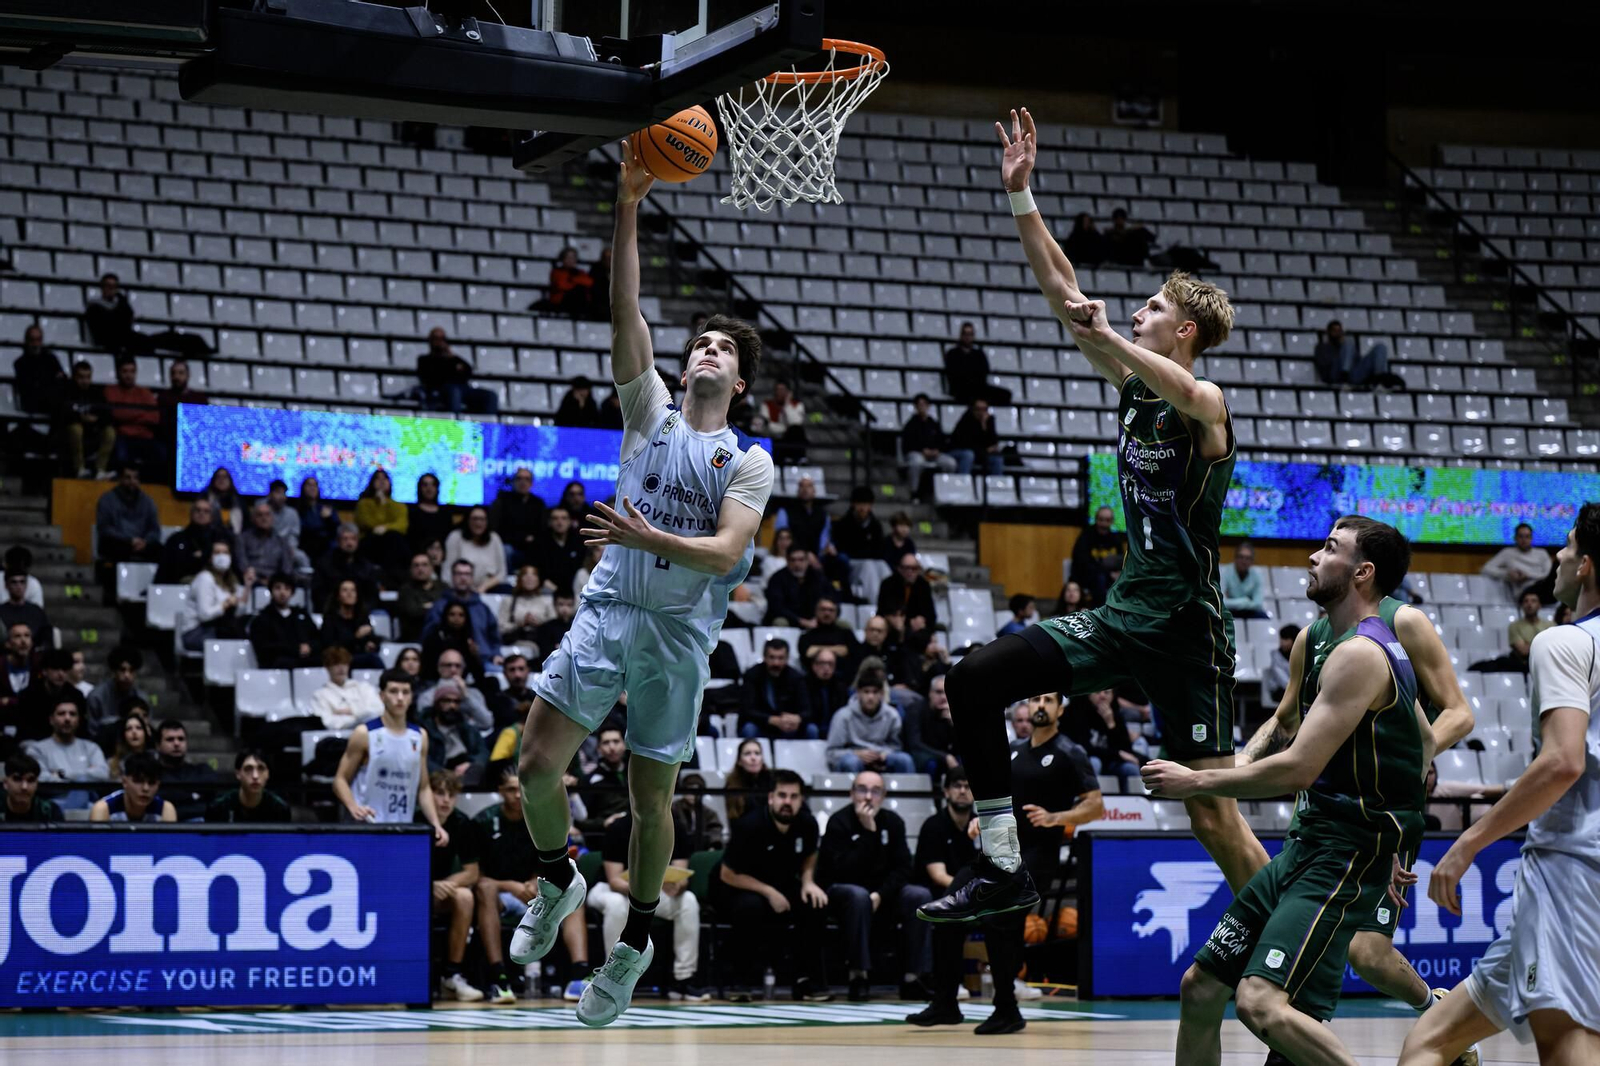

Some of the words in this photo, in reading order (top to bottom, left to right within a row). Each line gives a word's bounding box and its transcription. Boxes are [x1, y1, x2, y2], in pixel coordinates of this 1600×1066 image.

[665, 133, 709, 170] Wilson
[661, 484, 714, 514] PROBITAS
[1142, 516, 1154, 550] 1
[388, 793, 408, 814] 24
[1223, 913, 1251, 937] CLINICAS
[17, 969, 151, 995] EXERCISE
[162, 968, 236, 991] YOUR
[248, 966, 377, 989] FREEDOM
